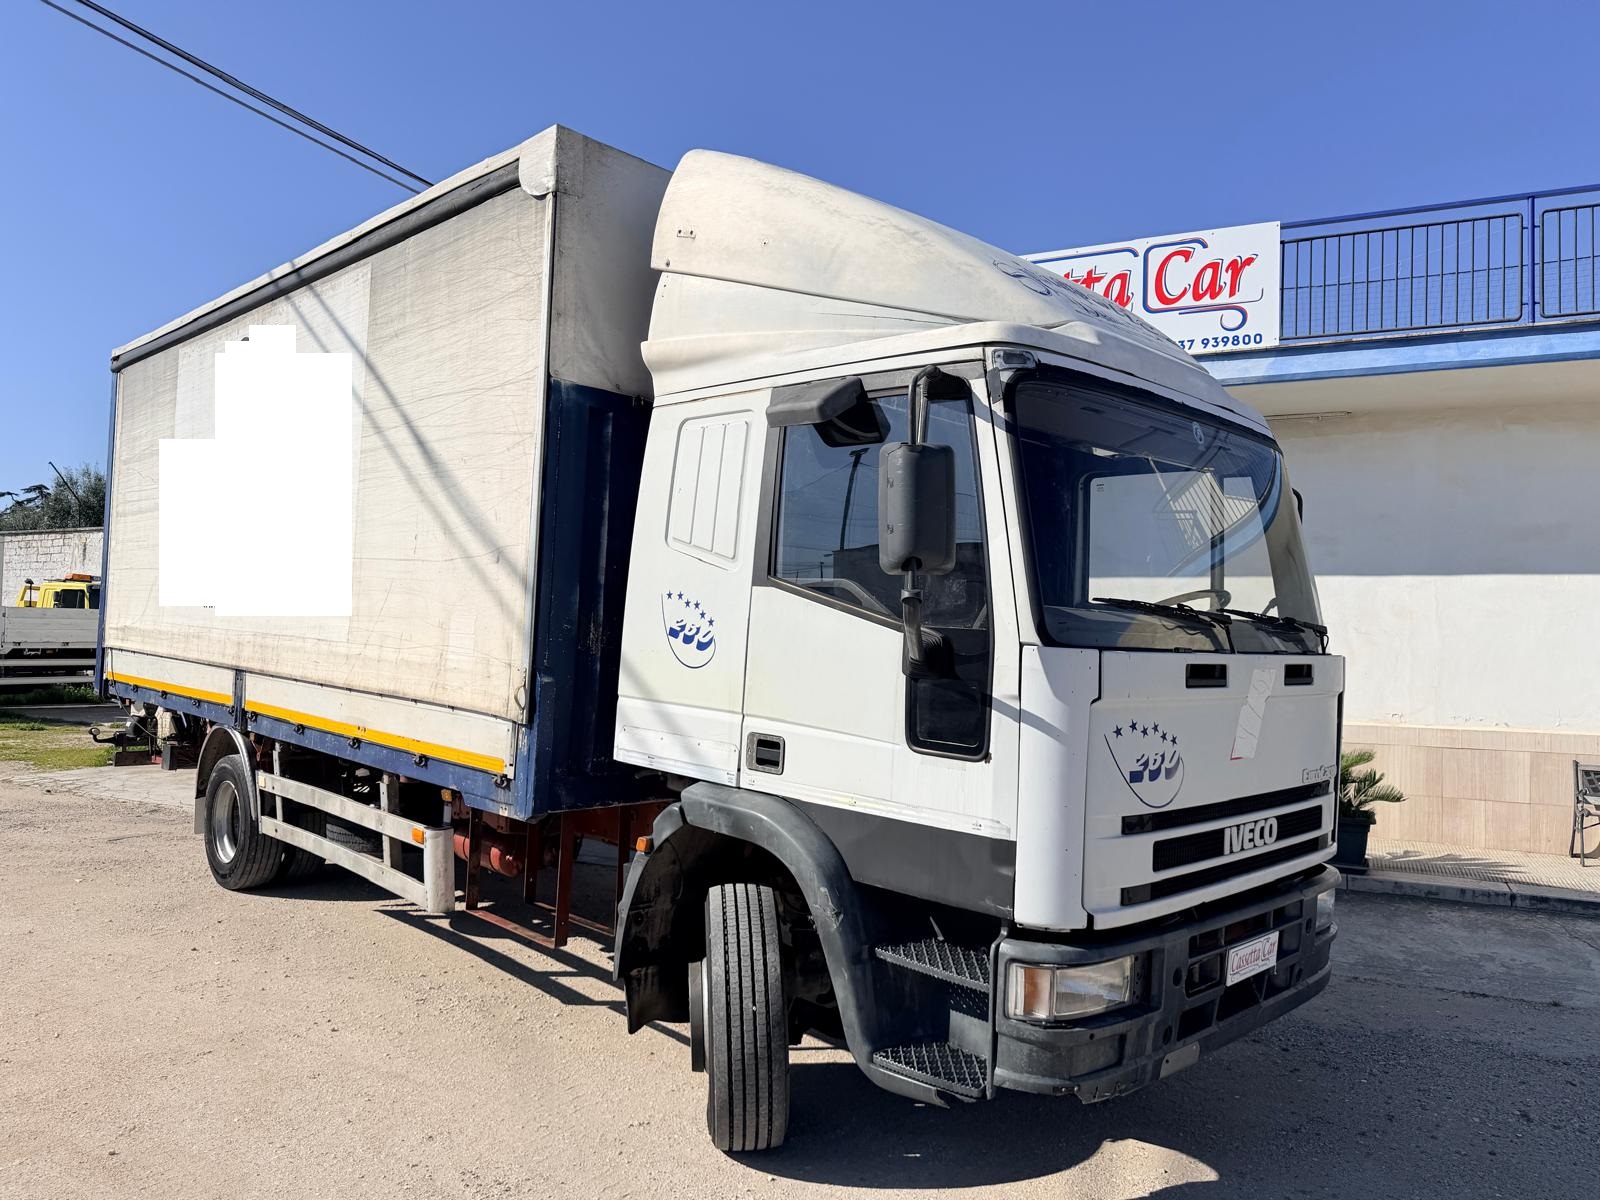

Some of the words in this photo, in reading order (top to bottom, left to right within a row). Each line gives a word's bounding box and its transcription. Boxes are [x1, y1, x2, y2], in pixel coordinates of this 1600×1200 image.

[1154, 246, 1258, 305] Car
[1201, 333, 1263, 349] 939800
[1223, 817, 1278, 855] IVECO
[1231, 947, 1261, 972] Cassetta
[1263, 939, 1277, 958] Car
